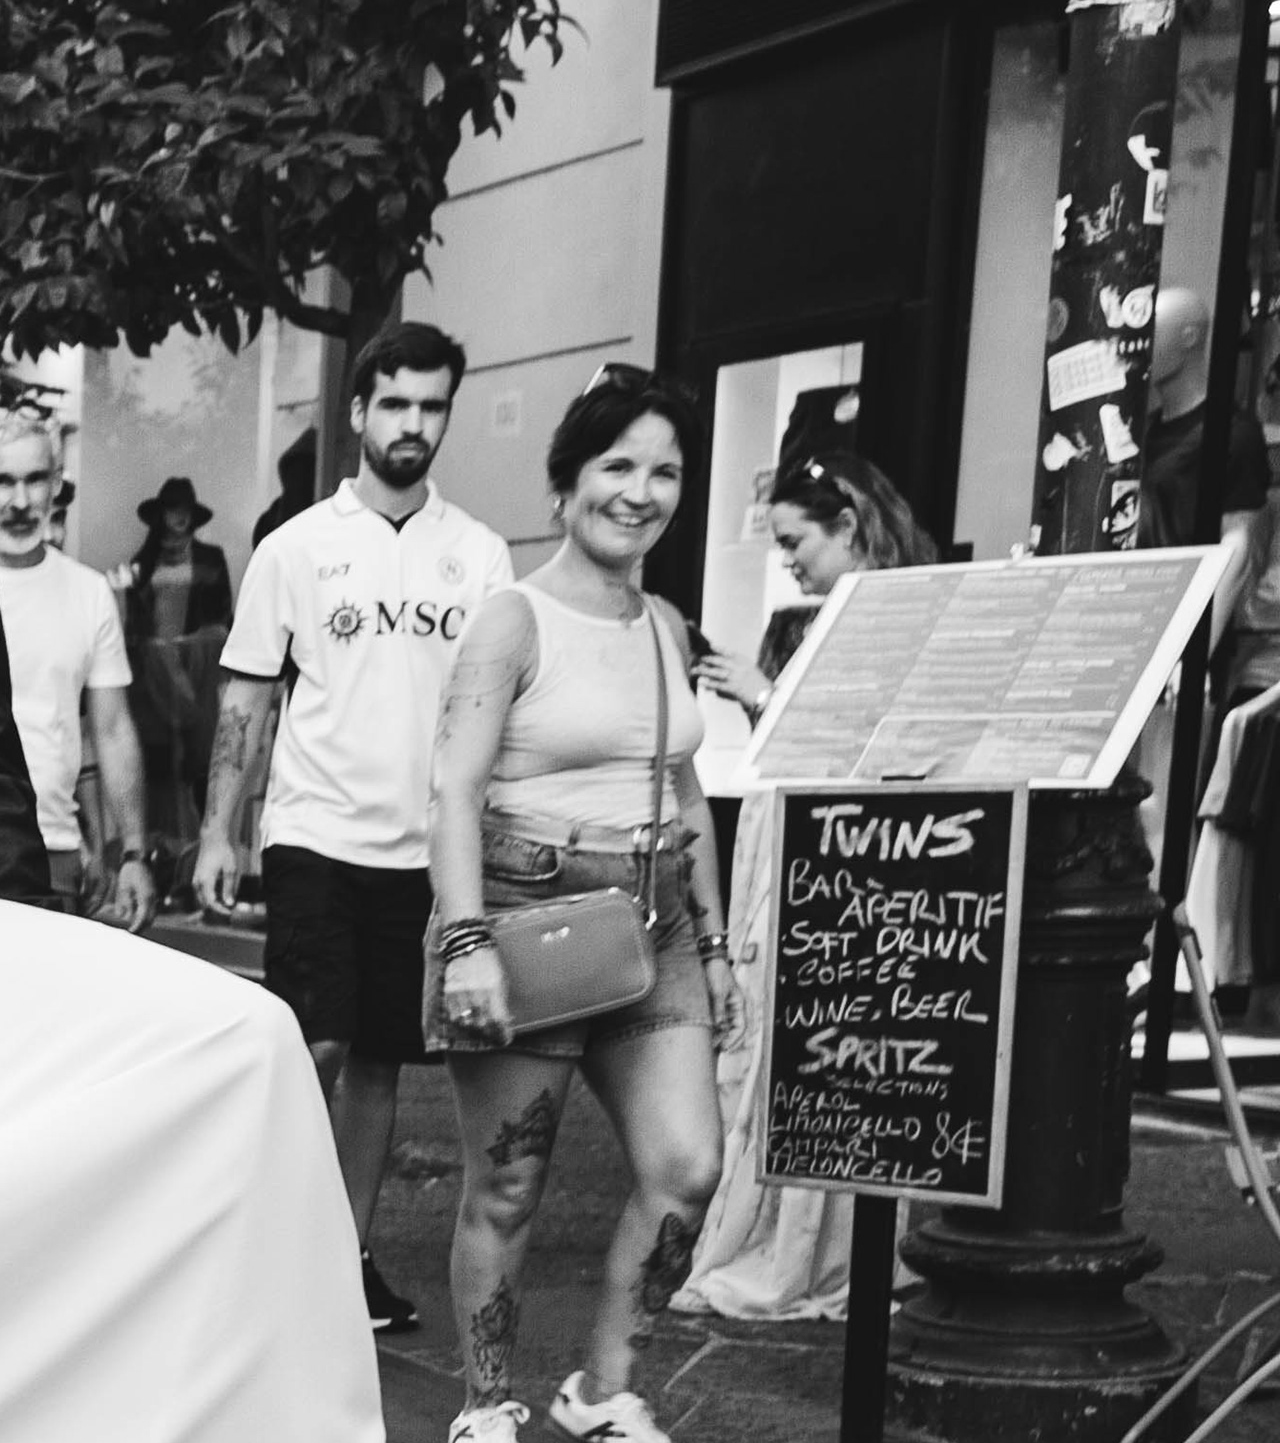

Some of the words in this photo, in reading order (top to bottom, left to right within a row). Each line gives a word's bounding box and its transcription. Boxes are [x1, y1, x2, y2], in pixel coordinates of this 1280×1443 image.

[375, 600, 466, 641] MSC
[811, 803, 985, 861] TWINS
[837, 889, 1004, 929] APERITIF
[876, 925, 989, 964] DRINK
[891, 983, 989, 1024] BEER
[797, 1026, 954, 1077] SPRITZ
[773, 1081, 861, 1113] APEROL
[770, 1110, 921, 1141] LIMONCELLO
[931, 1111, 986, 1166] 8€
[767, 1134, 877, 1159] CAMPARI
[772, 1153, 942, 1186] MELONCELLO
